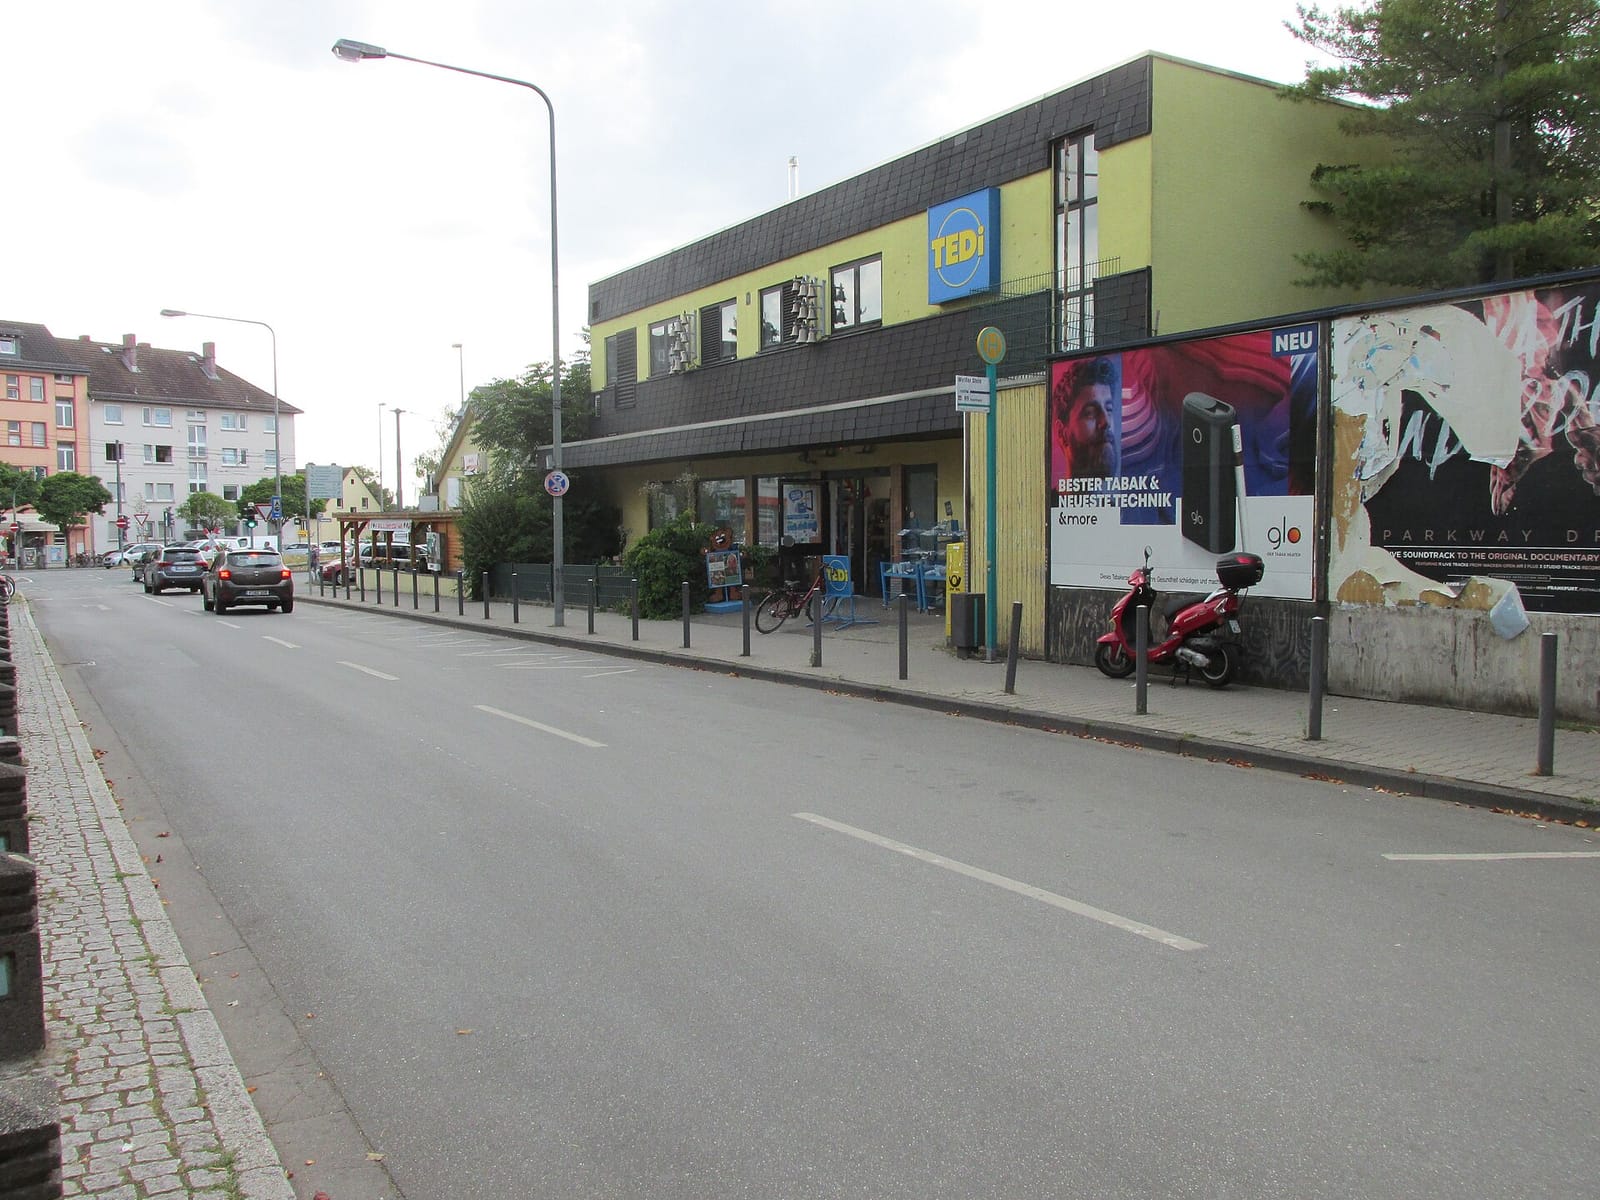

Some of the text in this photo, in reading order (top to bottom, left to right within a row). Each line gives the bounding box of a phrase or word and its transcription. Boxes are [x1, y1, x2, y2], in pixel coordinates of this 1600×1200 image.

[931, 225, 985, 269] TEDi
[1275, 331, 1313, 353] NEU
[1058, 475, 1160, 492] BESTER TABAK &
[1058, 492, 1172, 508] NEUESTE TECHNIK
[1058, 511, 1098, 526] &more
[1267, 515, 1302, 550] glo
[1383, 529, 1532, 542] PARKWAY
[1402, 551, 1456, 560] SOUNDTRACK
[1456, 552, 1469, 560] TO
[1470, 552, 1487, 560] THE
[1487, 552, 1529, 561] ORIGINAL
[1530, 553, 1600, 562] DOCUMENTARY
